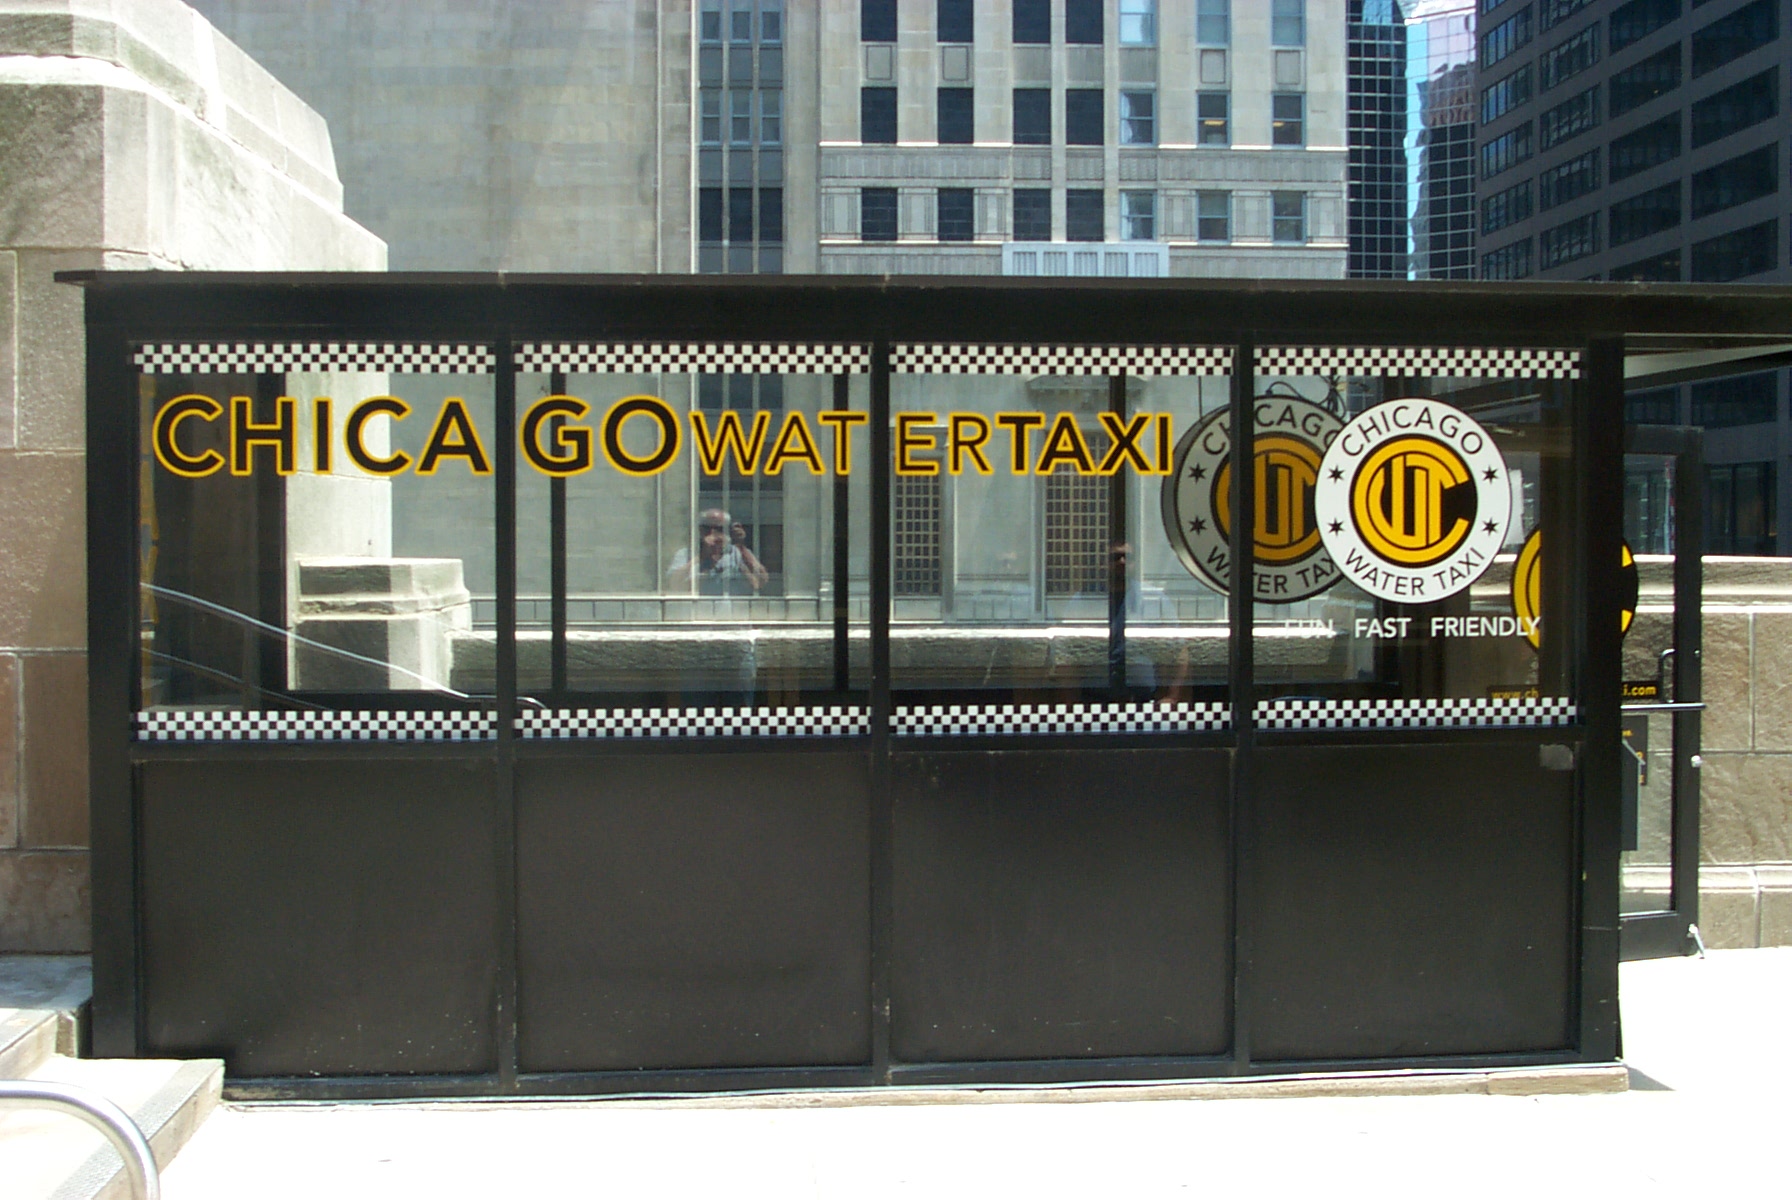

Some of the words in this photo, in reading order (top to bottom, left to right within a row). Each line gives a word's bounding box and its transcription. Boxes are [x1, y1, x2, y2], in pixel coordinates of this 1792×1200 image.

[1341, 405, 1483, 457] CHICAGO
[1345, 547, 1425, 596] WATER
[1432, 547, 1485, 590] TAXI
[1284, 618, 1334, 639] FUN
[1354, 617, 1412, 639] FAST
[1430, 616, 1541, 638] FRIENDLY
